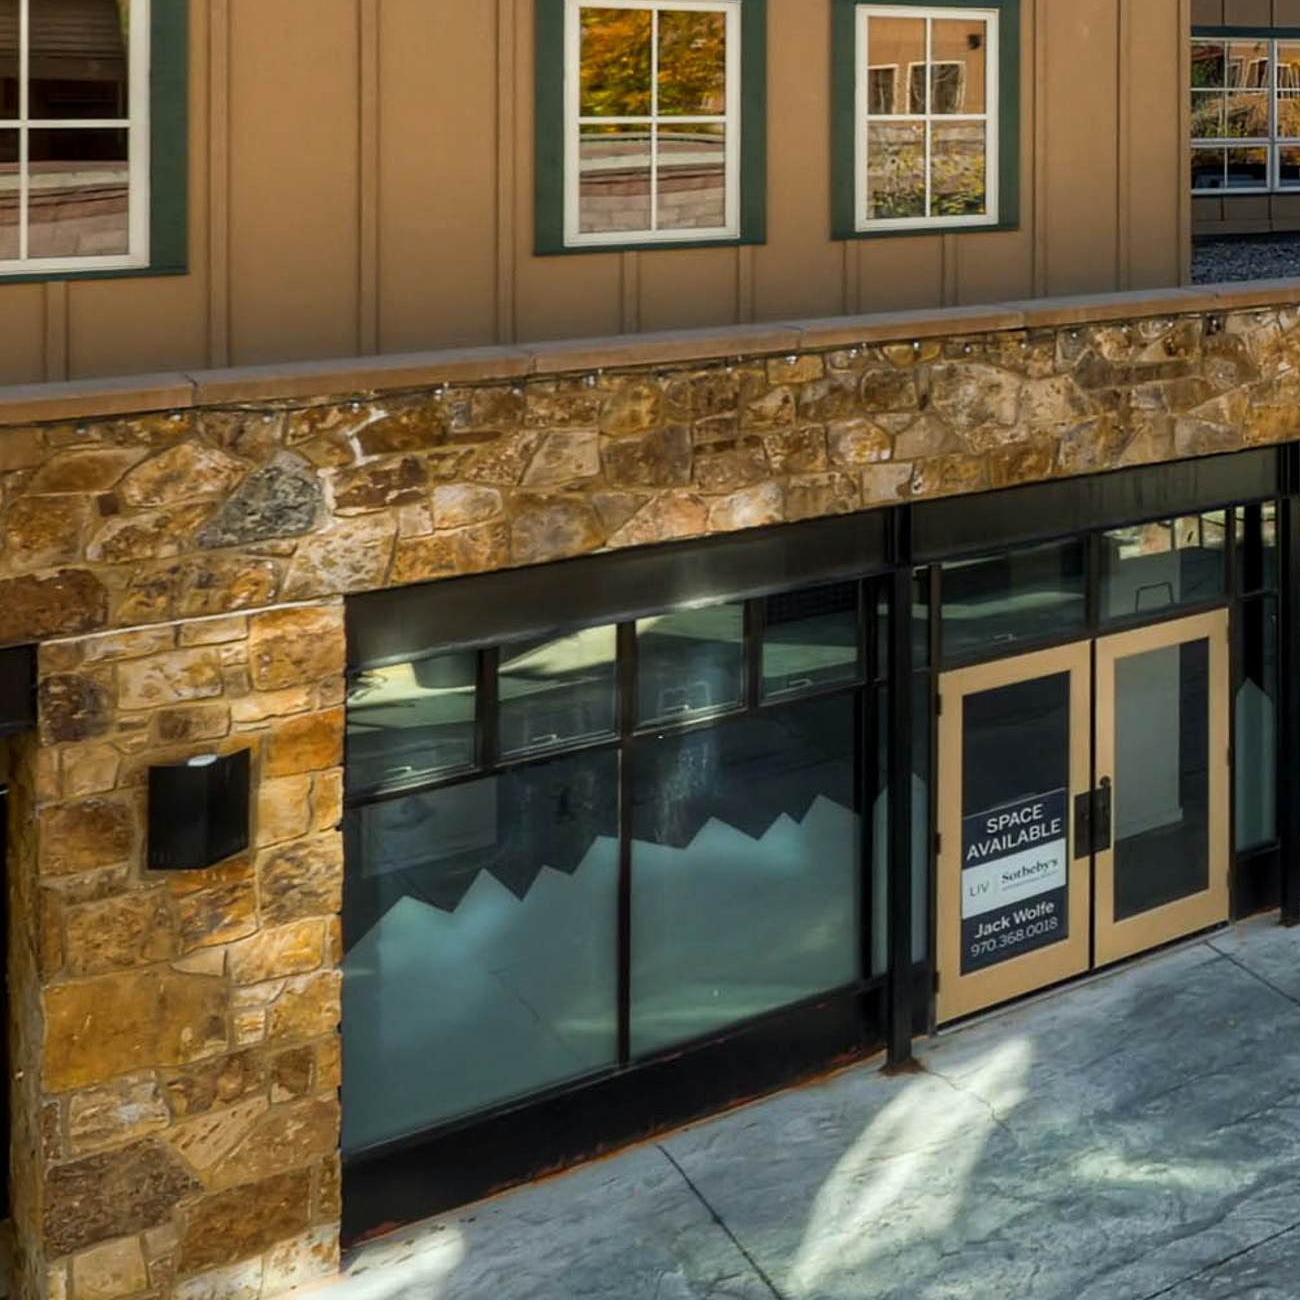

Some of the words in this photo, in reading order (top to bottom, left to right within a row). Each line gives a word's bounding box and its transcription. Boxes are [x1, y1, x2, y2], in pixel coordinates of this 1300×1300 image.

[986, 803, 1043, 834] SPACE
[966, 818, 1061, 861] AVAILABLE
[969, 880, 990, 897] LIV
[970, 916, 1059, 958] 970.368.0018
[974, 915, 1011, 939] Jack
[1012, 901, 1055, 925] Wolfe
